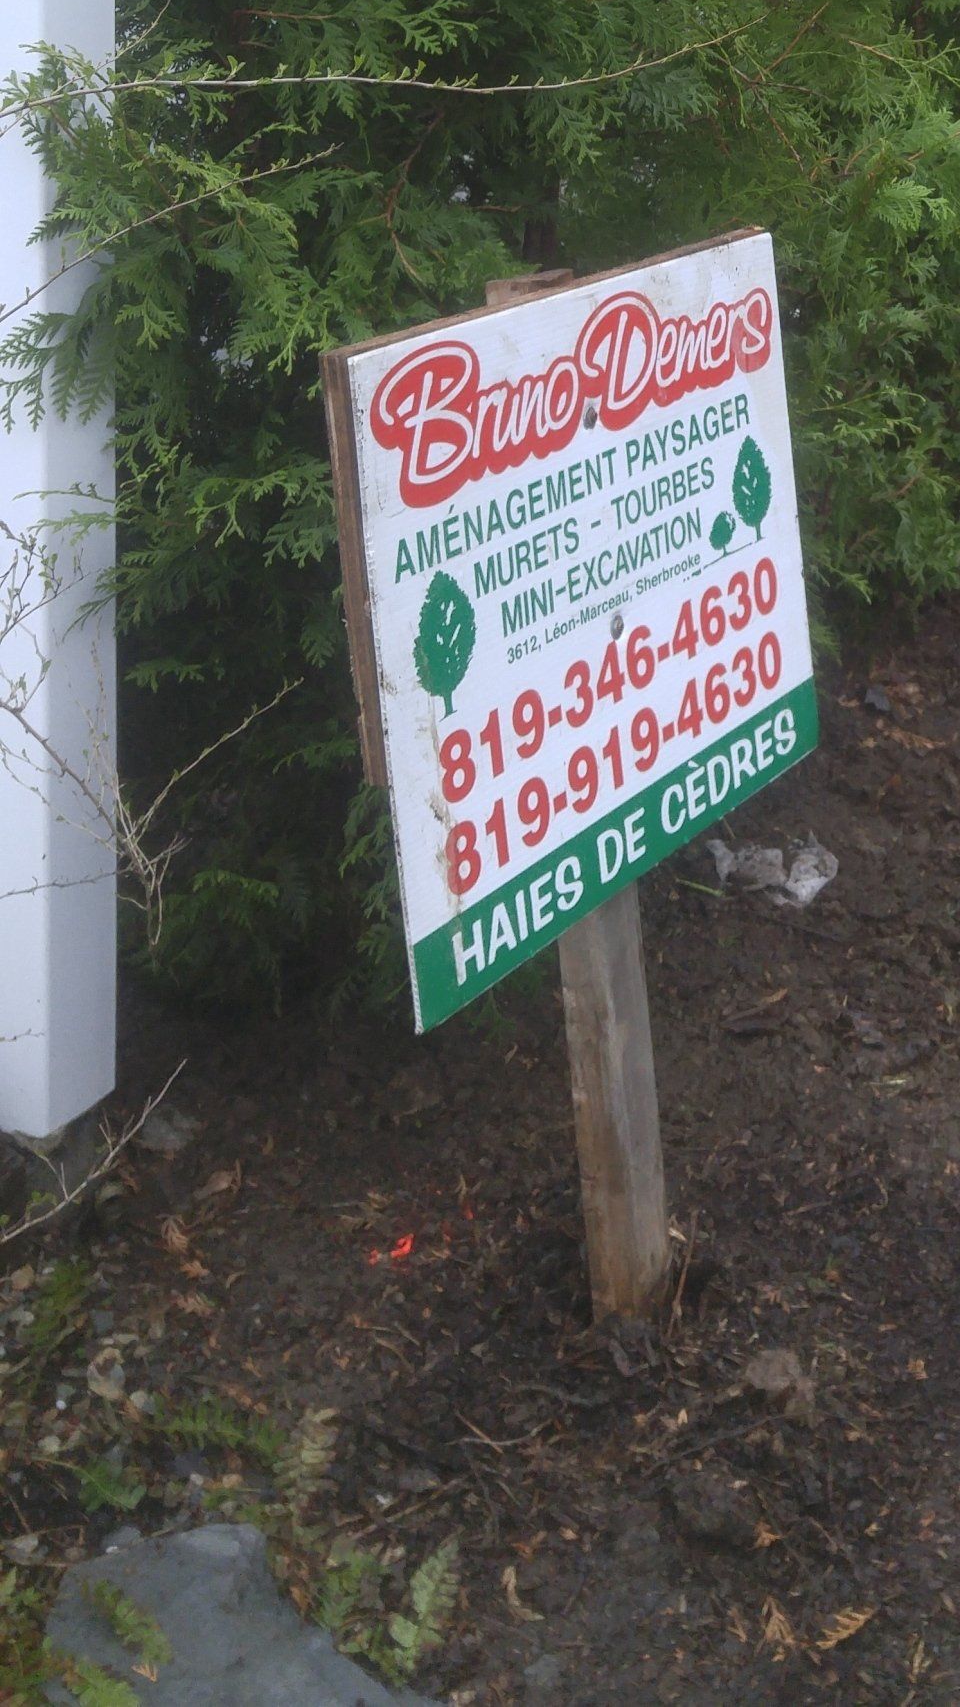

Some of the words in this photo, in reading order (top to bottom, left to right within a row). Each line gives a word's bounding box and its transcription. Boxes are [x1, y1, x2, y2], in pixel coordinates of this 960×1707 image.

[372, 341, 582, 499] Bruno
[577, 290, 769, 422] Demers
[394, 446, 618, 584] AMÉNAGEMENT
[624, 393, 751, 477] PAYSAGER
[473, 517, 580, 599] MURETS
[610, 456, 716, 531] TOURBES
[501, 507, 702, 639] MINI-EXCAVATION
[507, 635, 542, 664] 3612,
[545, 589, 633, 644] Léon-Marceau,
[636, 553, 701, 595] Sherbrooke
[439, 556, 778, 804] 819-346-4630
[446, 630, 782, 896] 819-919-4630
[452, 854, 584, 987] HAIES
[596, 807, 647, 886] DE
[660, 707, 798, 836] CÈDRES
